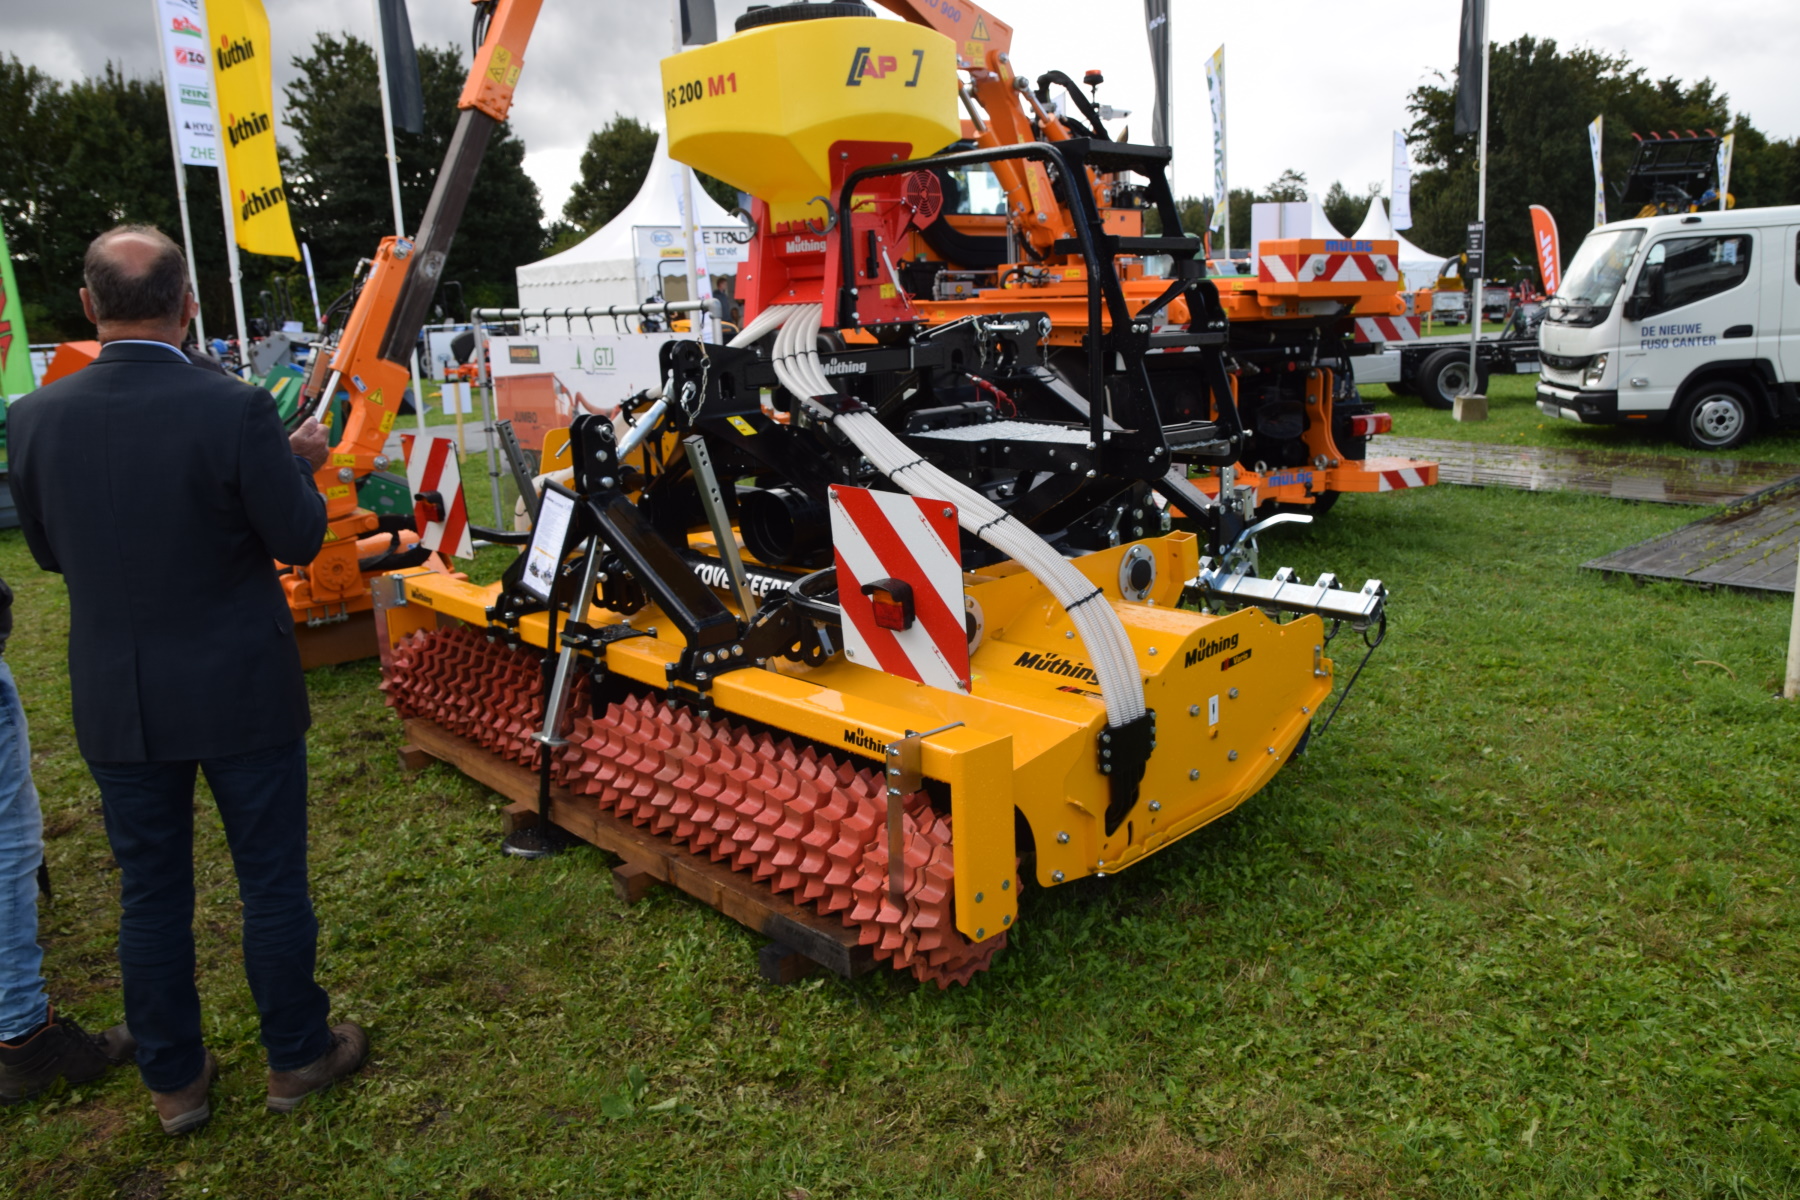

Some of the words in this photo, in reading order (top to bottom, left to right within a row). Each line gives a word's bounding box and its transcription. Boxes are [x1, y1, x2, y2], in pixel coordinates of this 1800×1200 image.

[941, 2, 962, 23] 900
[667, 88, 677, 110] PS
[678, 80, 703, 105] 200
[707, 72, 737, 98] M1
[786, 235, 827, 254] Müthing
[1325, 240, 1374, 252] MULAG
[1539, 230, 1556, 295] TIHL
[1641, 326, 1656, 337] DE
[1659, 323, 1702, 336] NIEUWE
[1641, 338, 1669, 350] FUSO
[1672, 336, 1717, 349] CANTER
[594, 347, 615, 366] GTJ
[513, 410, 538, 424] JUMBO
[1184, 632, 1239, 669] Müthing
